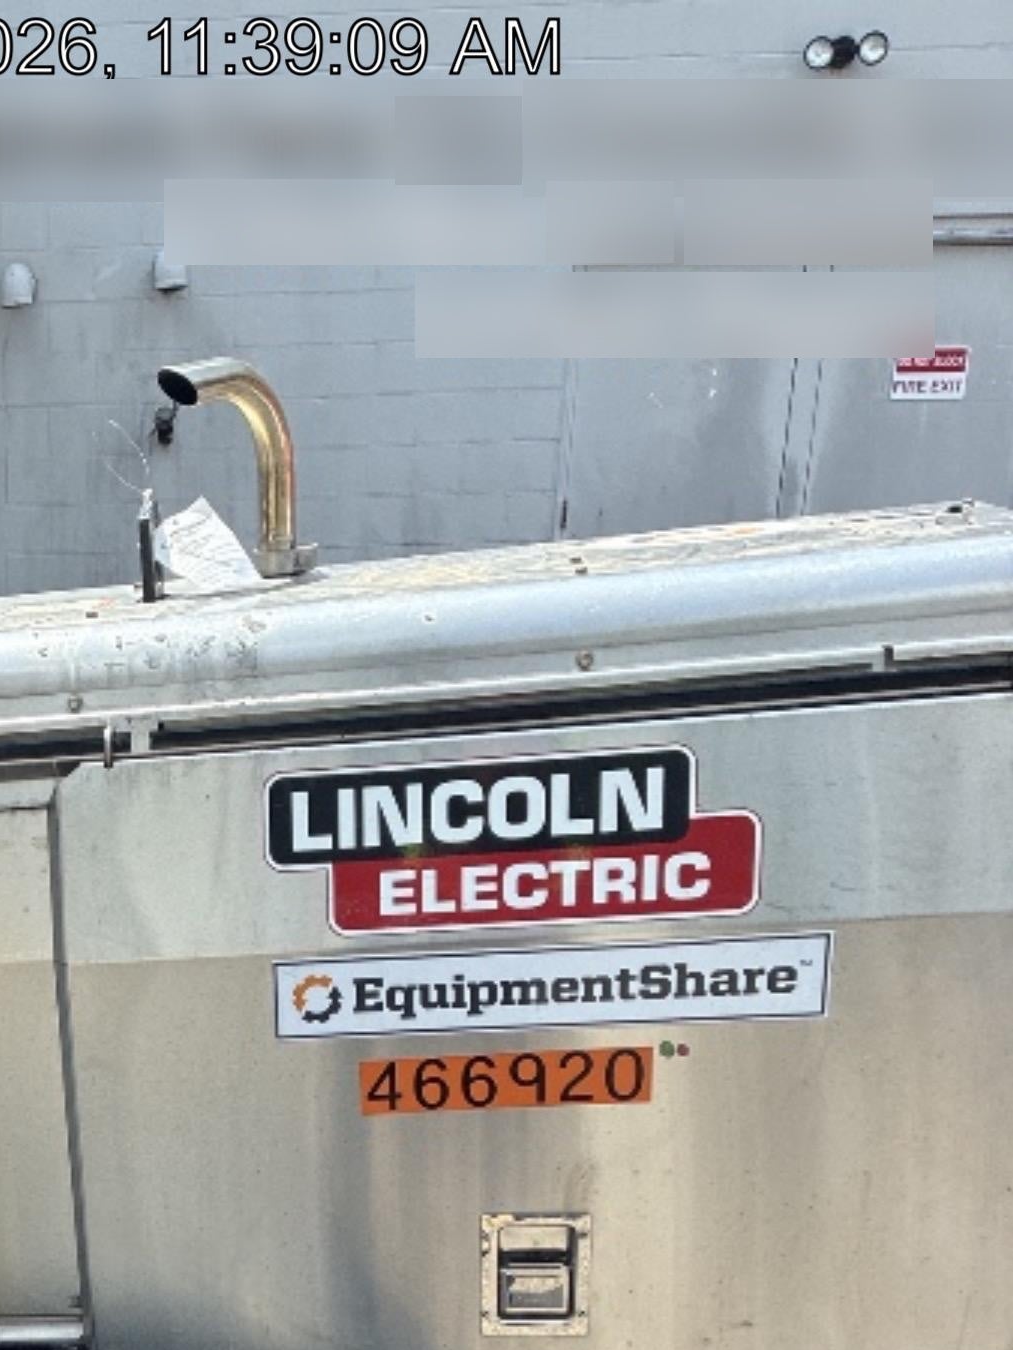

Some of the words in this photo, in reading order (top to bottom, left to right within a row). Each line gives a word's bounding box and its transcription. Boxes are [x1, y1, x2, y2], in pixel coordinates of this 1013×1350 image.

[289, 766, 665, 854] LINCOLN
[378, 851, 712, 917] ELECTRIC
[352, 963, 798, 1018] EquipmentShare
[366, 1048, 646, 1111] 466920
